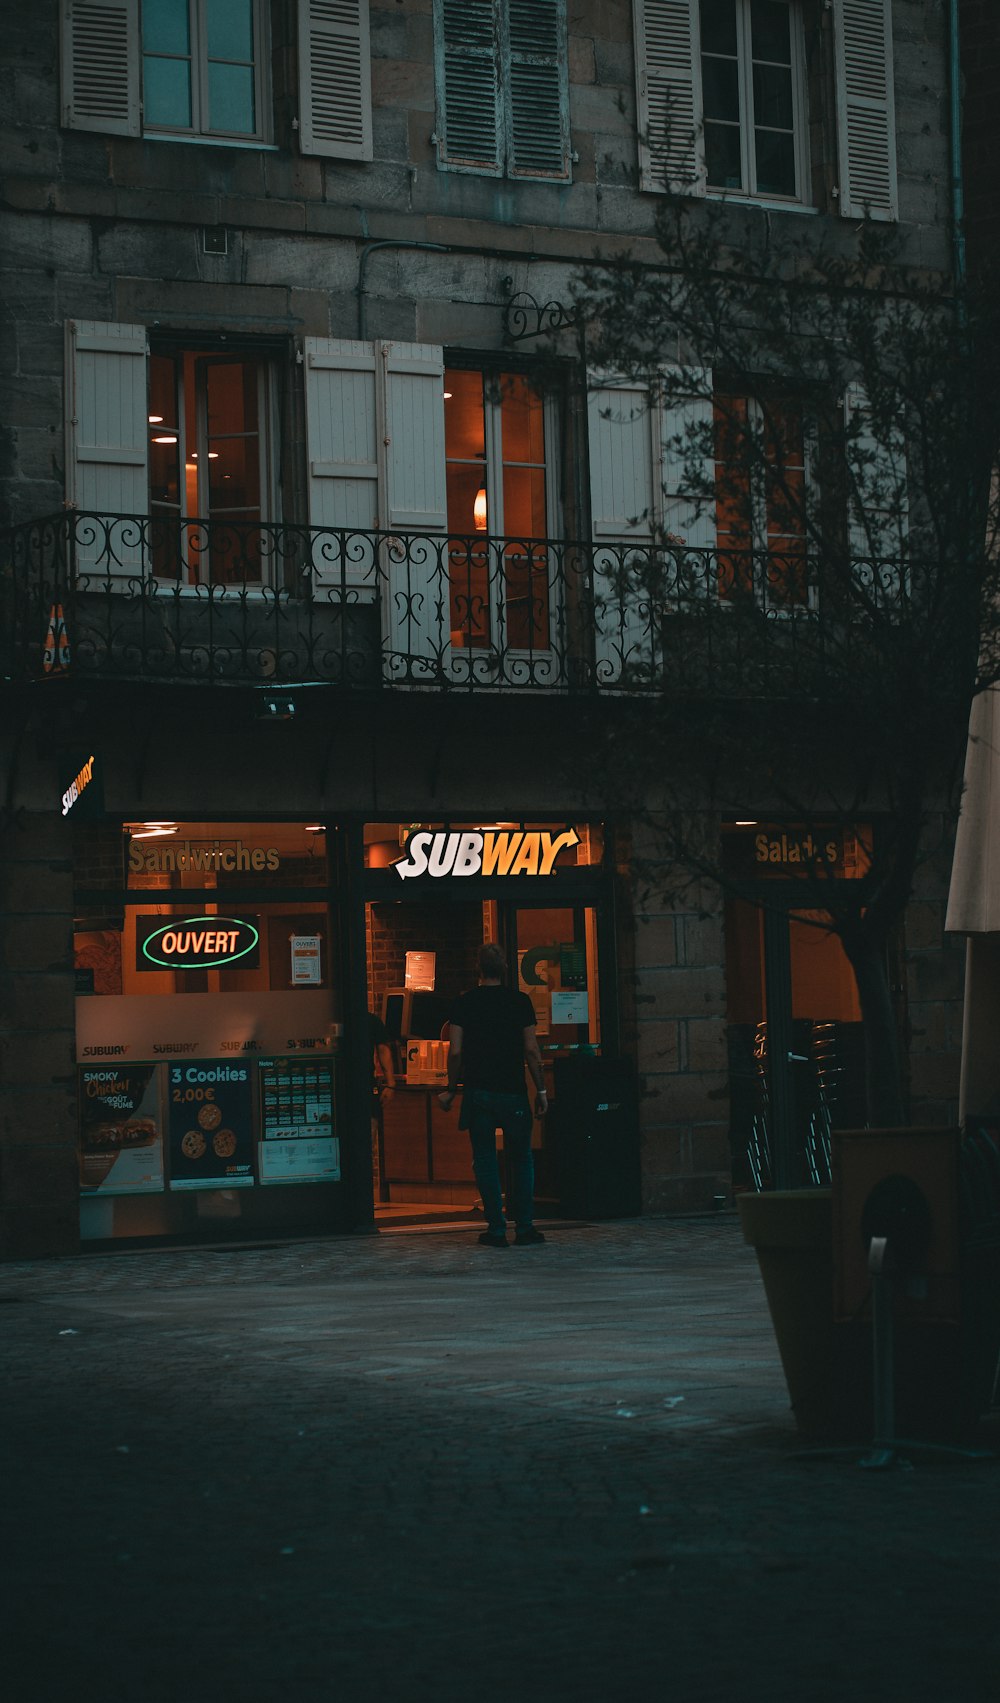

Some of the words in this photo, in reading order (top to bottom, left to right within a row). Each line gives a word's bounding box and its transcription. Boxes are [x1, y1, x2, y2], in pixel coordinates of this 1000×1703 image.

[60, 754, 96, 817] SUBWAY
[128, 840, 280, 871] Sandwiches
[395, 827, 582, 880] SUBWAY
[755, 833, 838, 863] Salads
[161, 930, 241, 955] OUVERT
[82, 1045, 131, 1057] SUBWAY
[153, 1042, 200, 1054] SUBWAY
[83, 1071, 119, 1082] SMOKY
[171, 1068, 183, 1083] 3
[185, 1066, 247, 1083] Cookies
[86, 1079, 130, 1098] Chicken
[172, 1087, 216, 1104] 2,00€
[106, 1094, 128, 1103] GOÛT
[113, 1100, 134, 1109] FUMÉ
